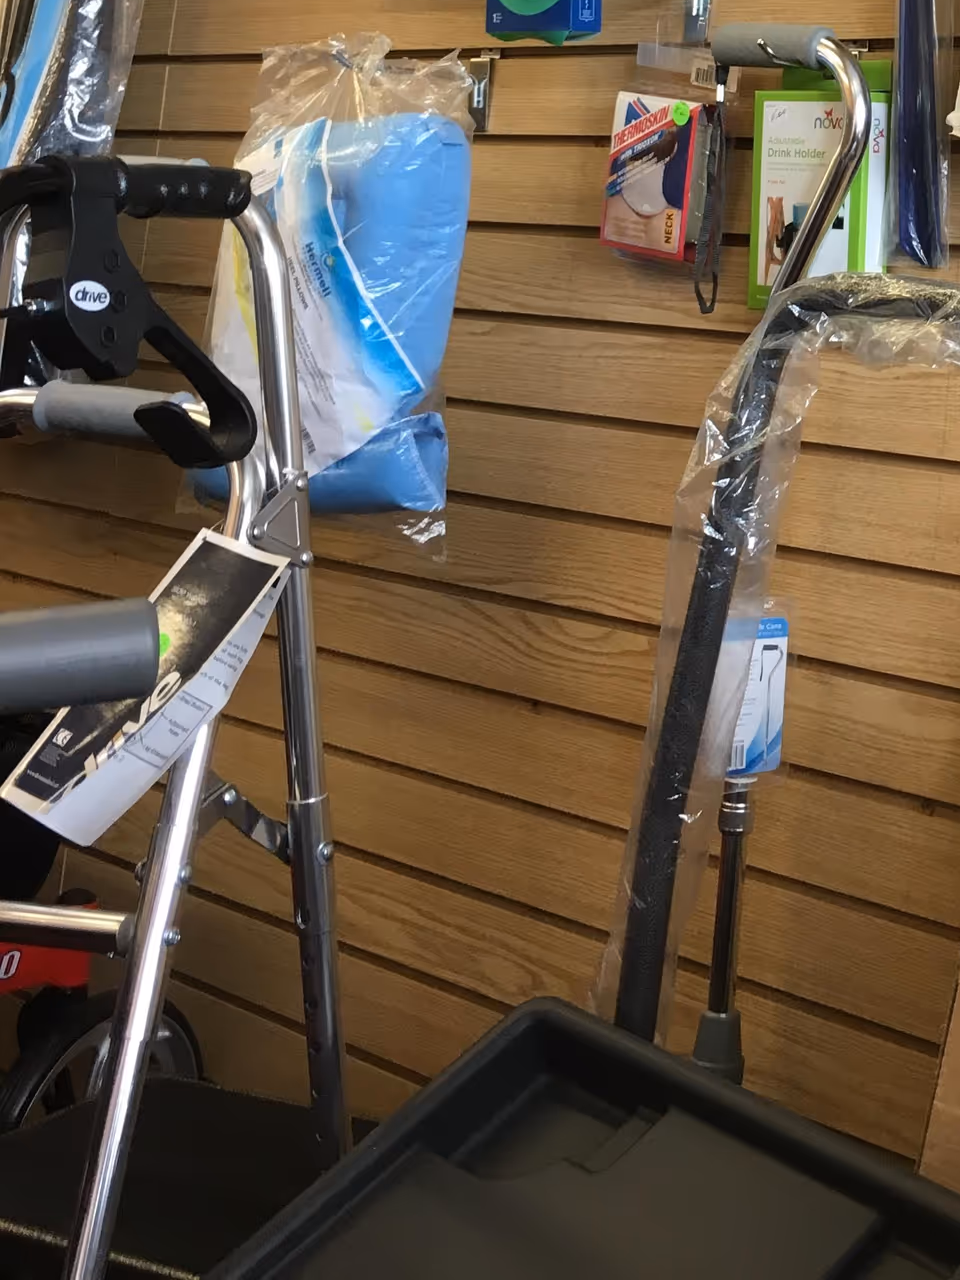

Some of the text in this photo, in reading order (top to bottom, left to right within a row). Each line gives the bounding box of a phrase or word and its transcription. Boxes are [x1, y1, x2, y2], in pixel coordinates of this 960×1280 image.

[613, 103, 671, 150] THERMOSKIN
[767, 135, 806, 145] Adjustable
[873, 117, 884, 154] nova
[767, 146, 827, 160] Drink Holder
[664, 211, 675, 245] NECK
[304, 241, 333, 298] Hermell
[74, 288, 111, 307] drive
